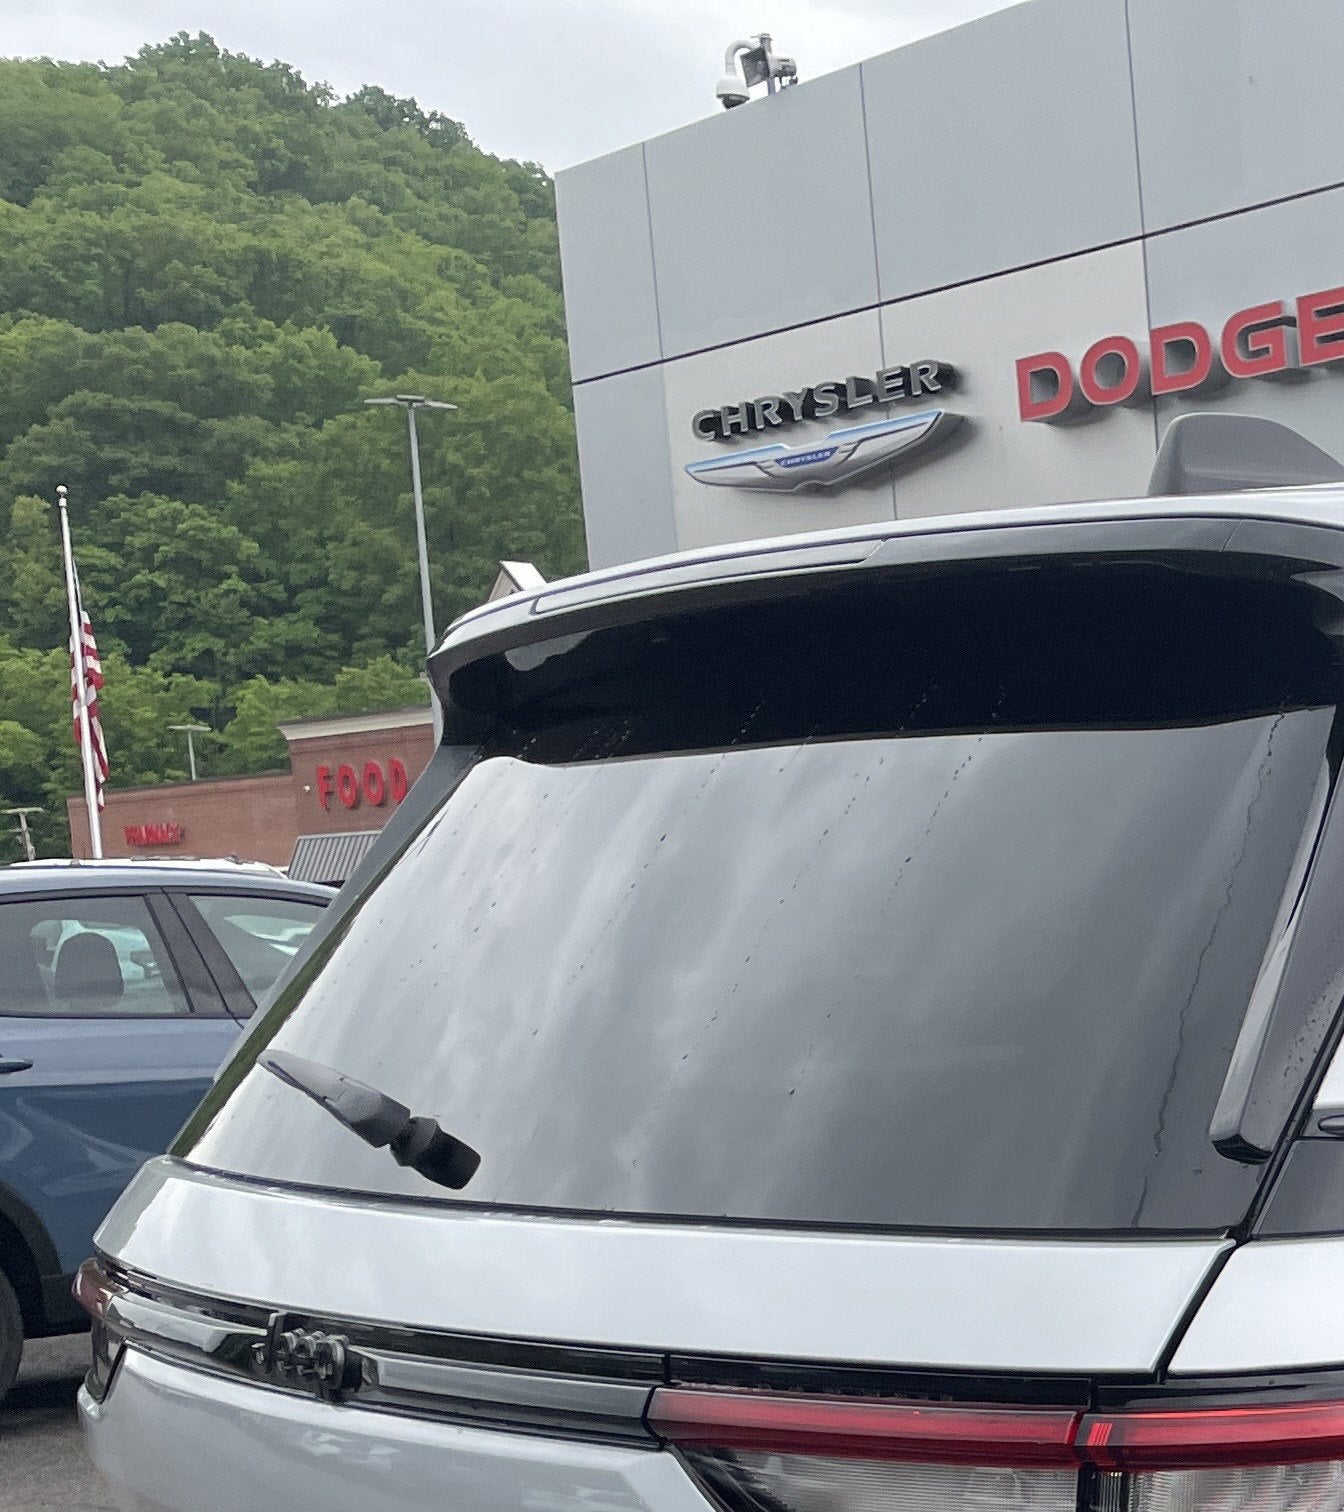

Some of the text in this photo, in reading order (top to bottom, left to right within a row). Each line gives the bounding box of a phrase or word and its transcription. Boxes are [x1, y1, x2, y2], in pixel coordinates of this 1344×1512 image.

[691, 359, 943, 442] CHRYSLER
[780, 451, 831, 467] CHRYSLER
[315, 756, 409, 811] FOOD
